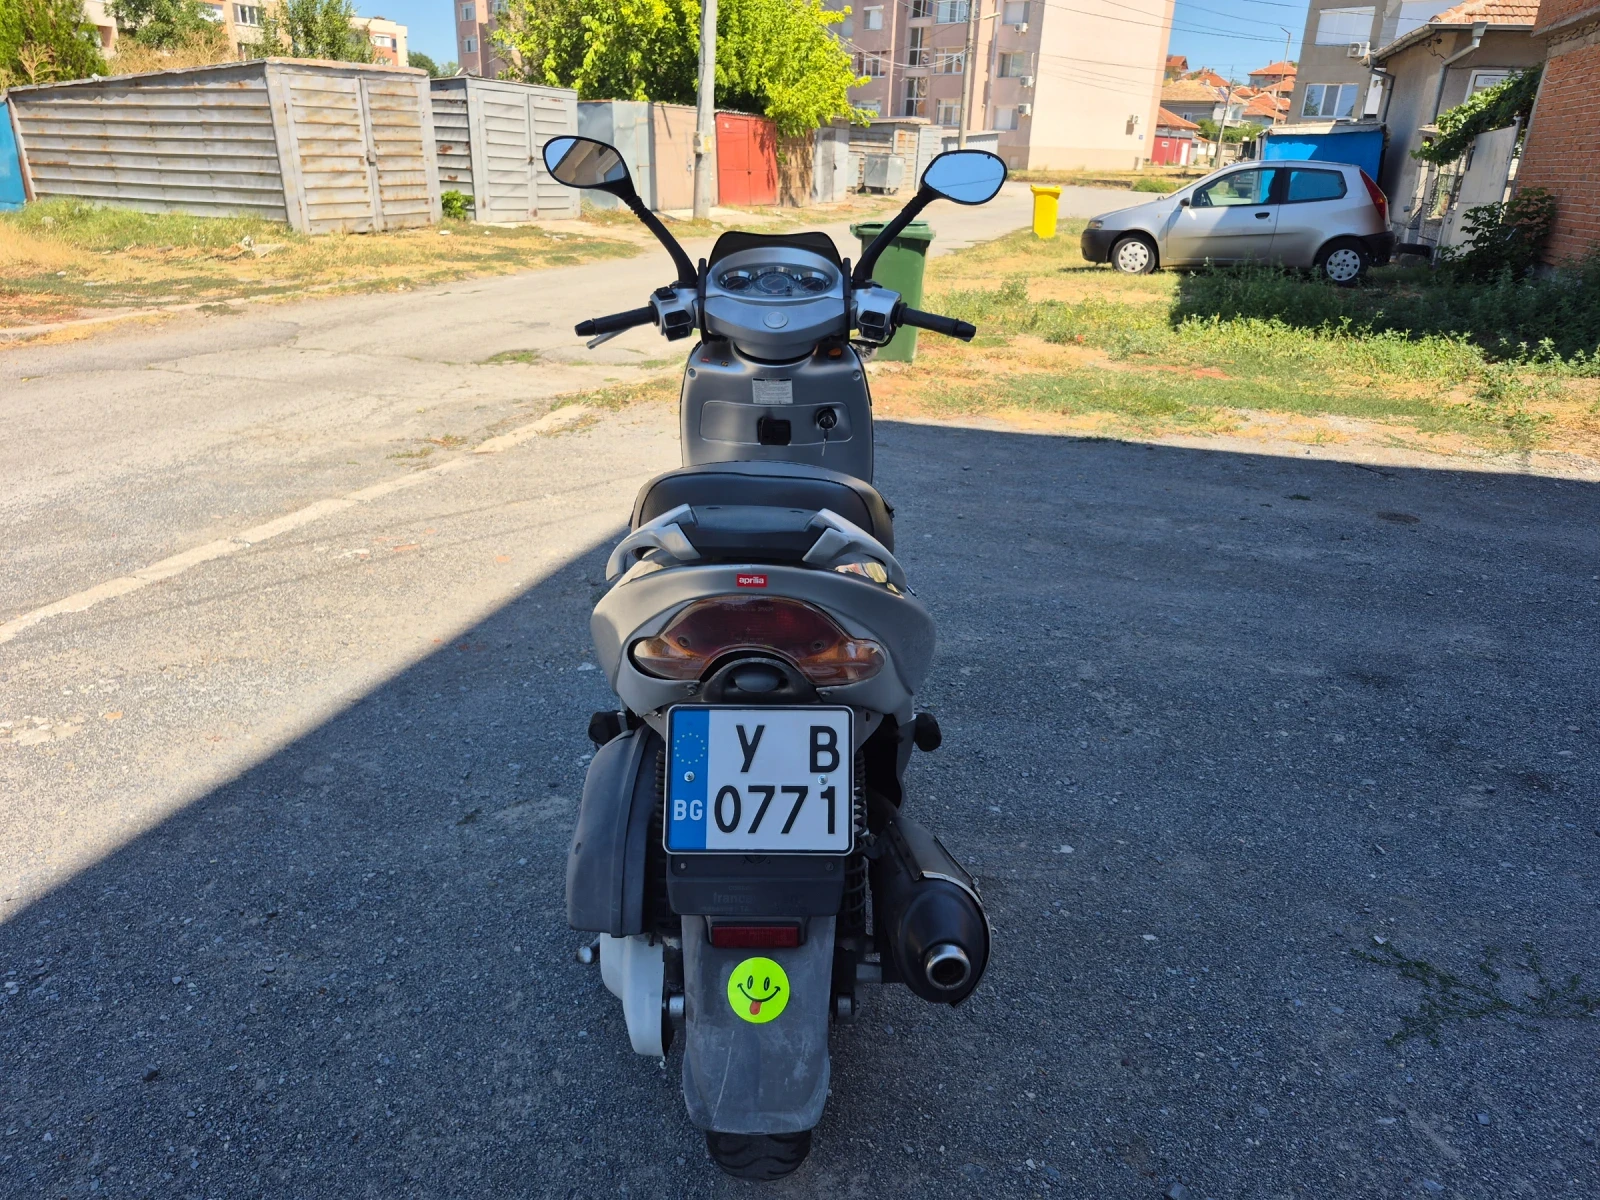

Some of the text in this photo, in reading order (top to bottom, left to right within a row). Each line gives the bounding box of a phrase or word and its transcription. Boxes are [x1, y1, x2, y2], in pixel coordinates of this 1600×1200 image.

[738, 576, 765, 585] aprilia
[673, 799, 703, 821] BG
[714, 785, 836, 835] 0771
